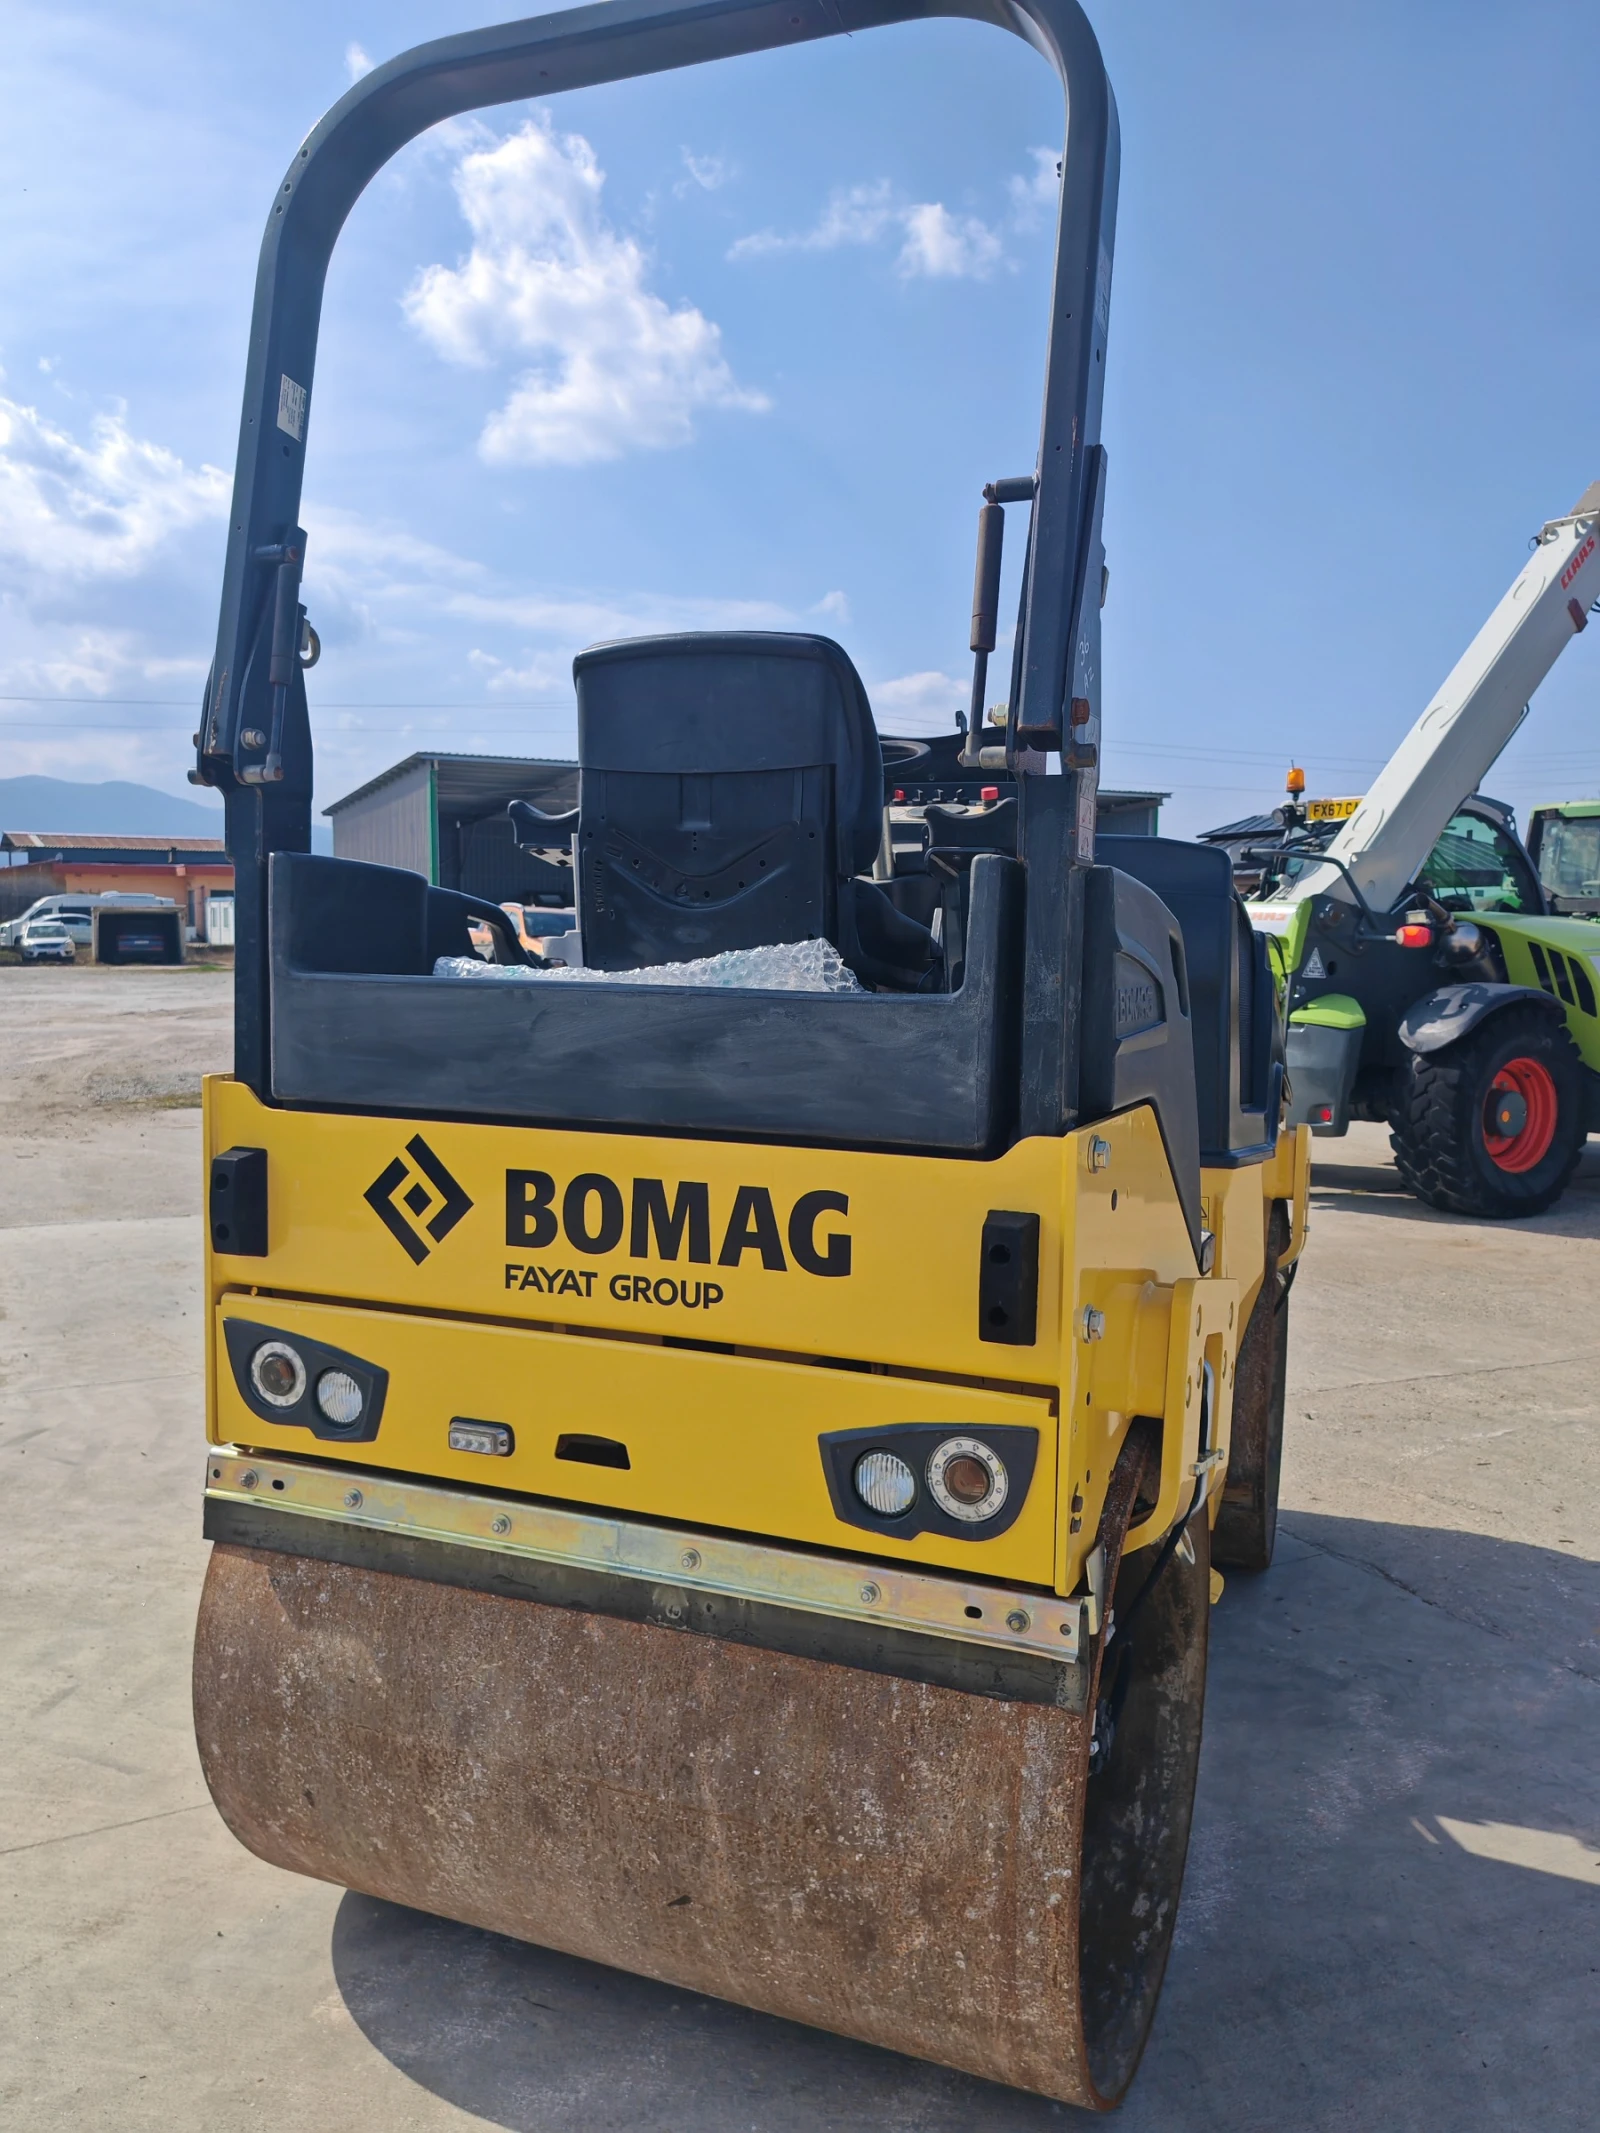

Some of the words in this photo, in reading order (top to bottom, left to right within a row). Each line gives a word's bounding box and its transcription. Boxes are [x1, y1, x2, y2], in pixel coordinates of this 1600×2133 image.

[1560, 535, 1596, 591] CLAAS
[1313, 803, 1343, 818] FX67
[505, 1168, 852, 1278] BOMAG
[504, 1263, 598, 1298] FAYAT
[608, 1273, 724, 1310] GROUP
